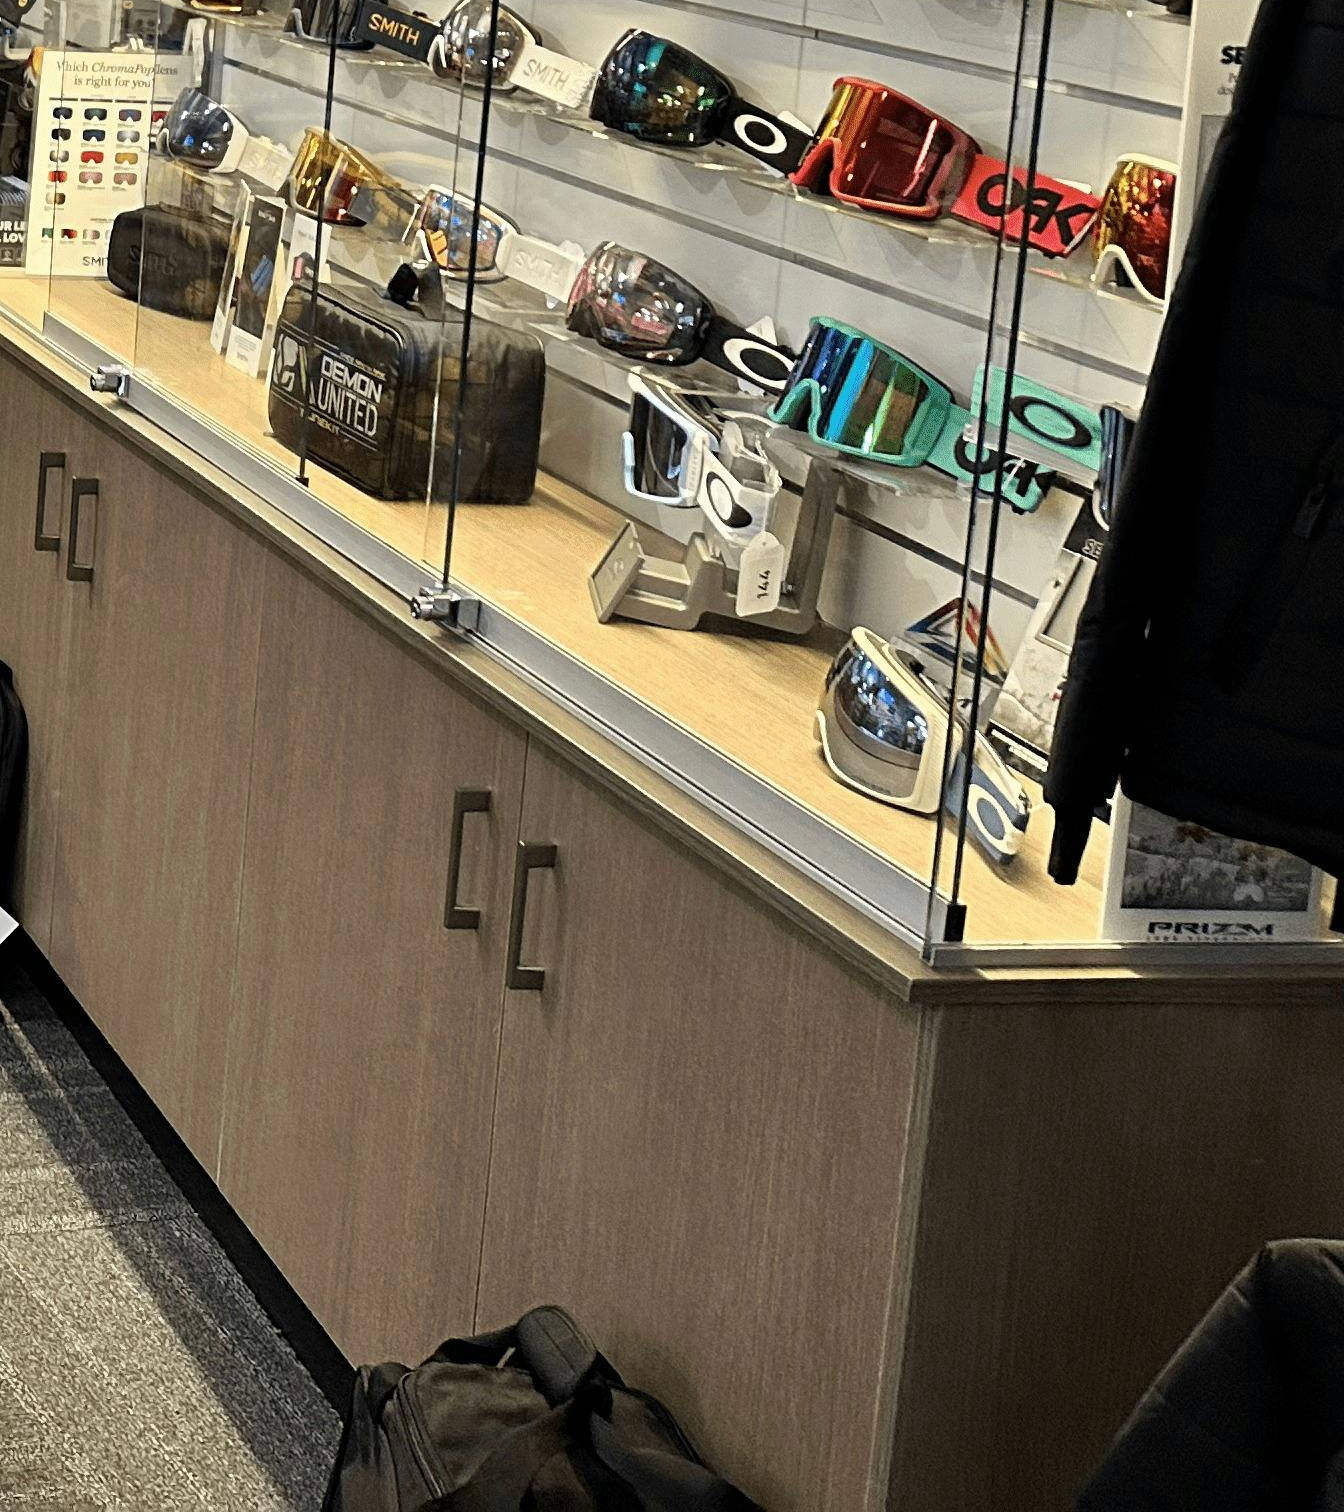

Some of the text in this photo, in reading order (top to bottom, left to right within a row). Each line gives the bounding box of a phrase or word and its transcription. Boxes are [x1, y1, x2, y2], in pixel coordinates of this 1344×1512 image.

[367, 13, 420, 47] SMITH
[74, 76, 83, 87] is
[84, 76, 113, 89] right
[115, 76, 130, 88] for
[523, 58, 571, 89] SMITH
[3, 232, 27, 243] LOV
[320, 355, 381, 403] DEMON
[318, 386, 379, 438] UNITED
[1148, 921, 1273, 936] PRIZM
